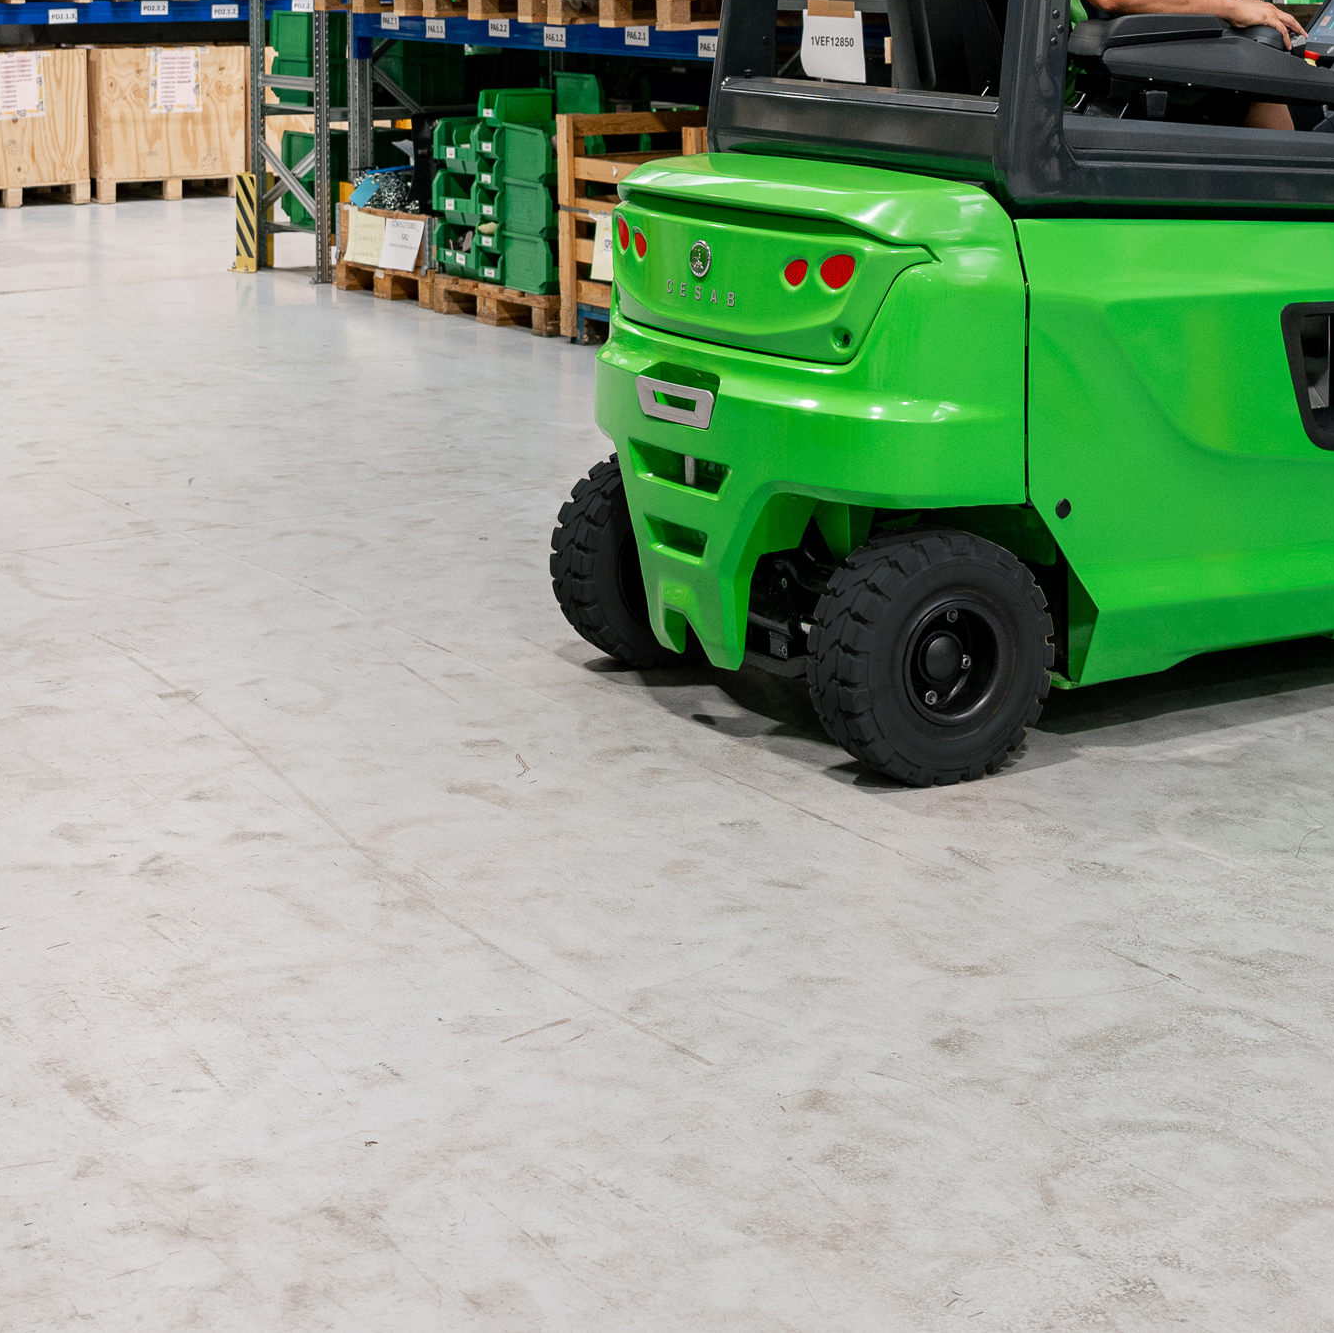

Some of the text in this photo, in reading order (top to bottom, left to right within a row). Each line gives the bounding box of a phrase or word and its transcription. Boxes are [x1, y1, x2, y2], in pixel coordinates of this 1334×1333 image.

[490, 22, 507, 33] PA6.2.2
[626, 29, 646, 42] PA6.2.1
[810, 35, 855, 49] 1VEF12850
[667, 278, 736, 307] CESAB
